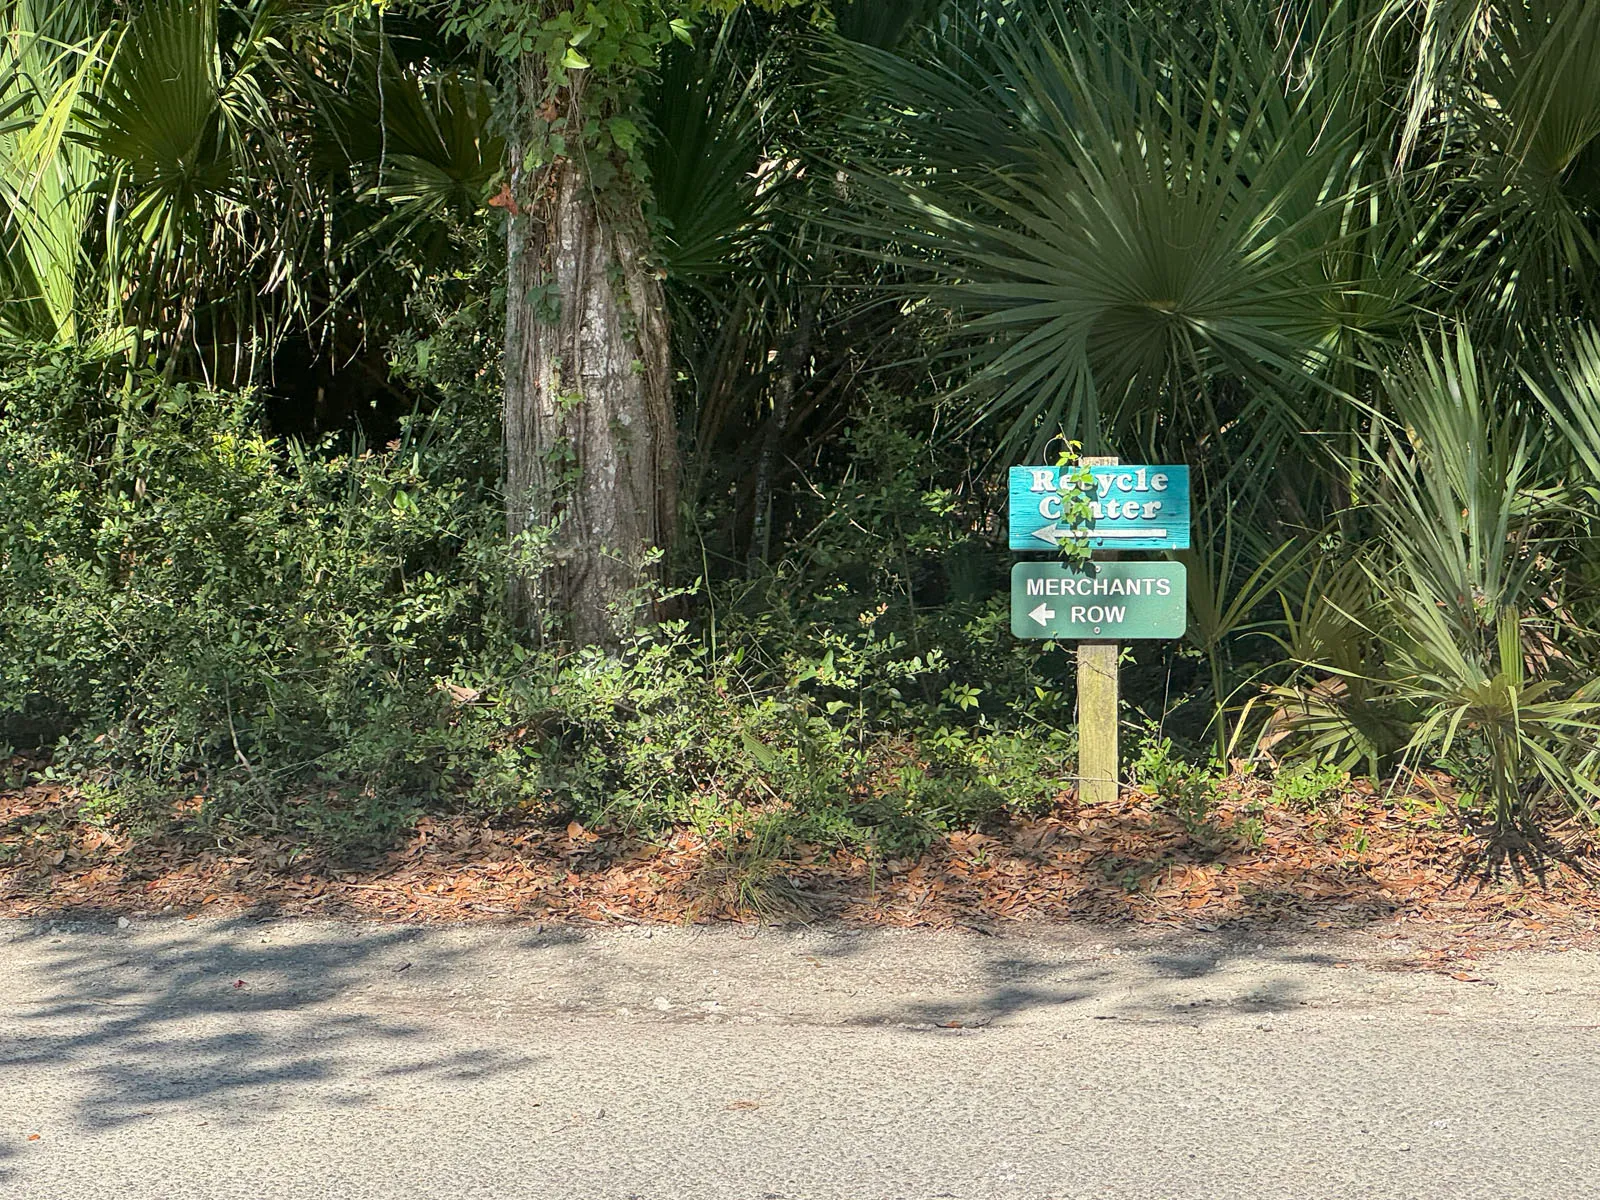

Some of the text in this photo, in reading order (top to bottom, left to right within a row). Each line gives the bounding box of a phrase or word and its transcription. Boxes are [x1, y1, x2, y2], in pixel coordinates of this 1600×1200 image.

[1039, 496, 1162, 520] Cnter
[1026, 578, 1171, 596] MERCHANTS
[1071, 606, 1126, 623] ROW
